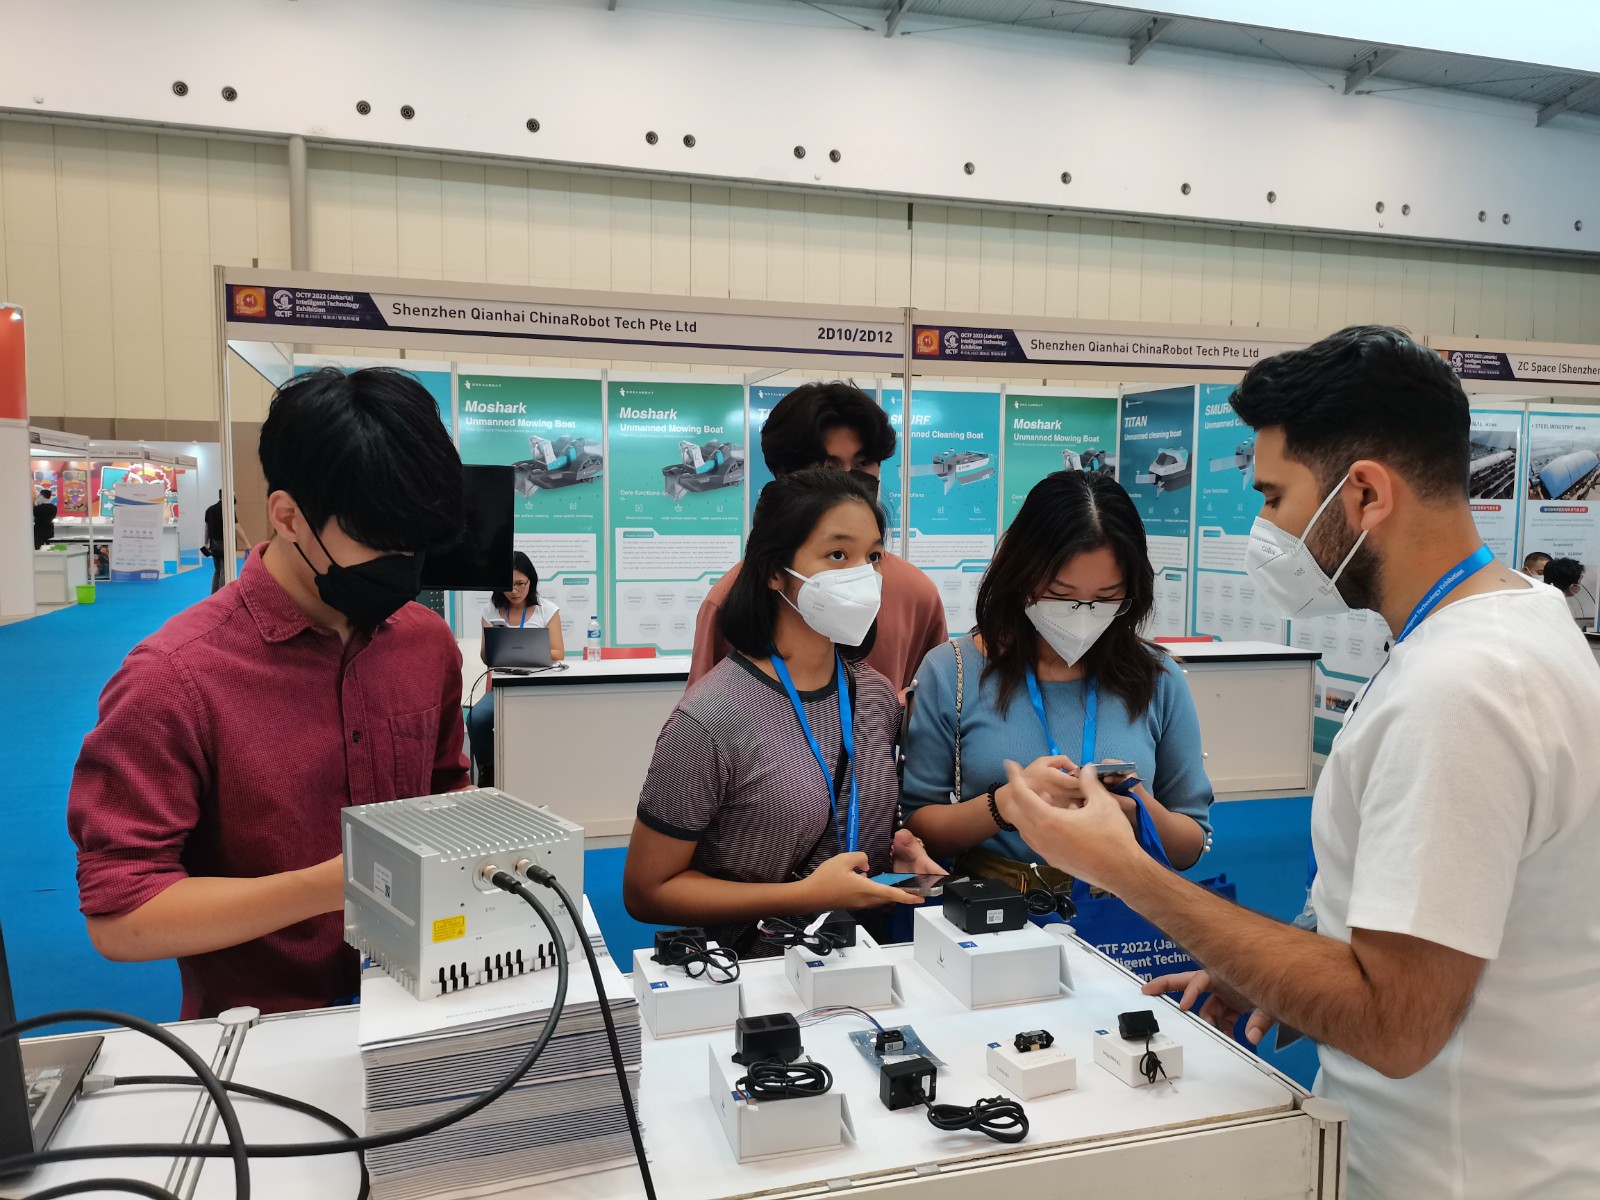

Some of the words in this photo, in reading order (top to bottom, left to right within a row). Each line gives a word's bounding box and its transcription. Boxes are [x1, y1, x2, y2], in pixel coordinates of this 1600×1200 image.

[296, 300, 326, 308] Intelligent
[327, 301, 359, 309] Technology
[392, 302, 467, 319] Shenzhen
[470, 307, 525, 324] Qianhai
[529, 311, 611, 329] ChinaRobot
[614, 316, 646, 331] Tech
[650, 319, 672, 332] Pte
[675, 320, 697, 333] Ltd
[817, 327, 893, 344] 2D10/2D12
[1030, 338, 1086, 353] Shenzhen
[1088, 340, 1129, 355] Qianhai
[1132, 342, 1193, 357] ChinaRobot
[1196, 346, 1220, 358] Tech
[1223, 347, 1241, 359] Pte
[1243, 347, 1259, 359] Ltd
[1517, 361, 1529, 371] ZC
[1531, 362, 1557, 374] Space
[464, 399, 527, 414] Moshark
[619, 406, 678, 421] Moshark
[465, 416, 516, 427] Unmanned
[517, 418, 553, 430] Mowing
[555, 419, 576, 429] Boat
[620, 423, 667, 433] Unmanned
[668, 424, 702, 435] Mowing
[703, 425, 724, 434] Boat
[1013, 418, 1063, 431] Moshark
[1124, 415, 1149, 429] TITAN
[1204, 420, 1235, 430] Unmanned
[931, 430, 965, 441] Cleaning
[966, 431, 984, 440] Boat
[1013, 433, 1053, 442] Unmanned
[1053, 434, 1082, 444] Mowing
[1083, 435, 1100, 443] Boat
[1124, 431, 1148, 441] Unmanned
[1148, 430, 1170, 440] cleaning
[1416, 588, 1442, 615] Technology
[1439, 569, 1465, 591] Exhibition
[1096, 943, 1119, 955] CTF
[1121, 940, 1152, 954] 2022
[1152, 951, 1192, 966] Techn
